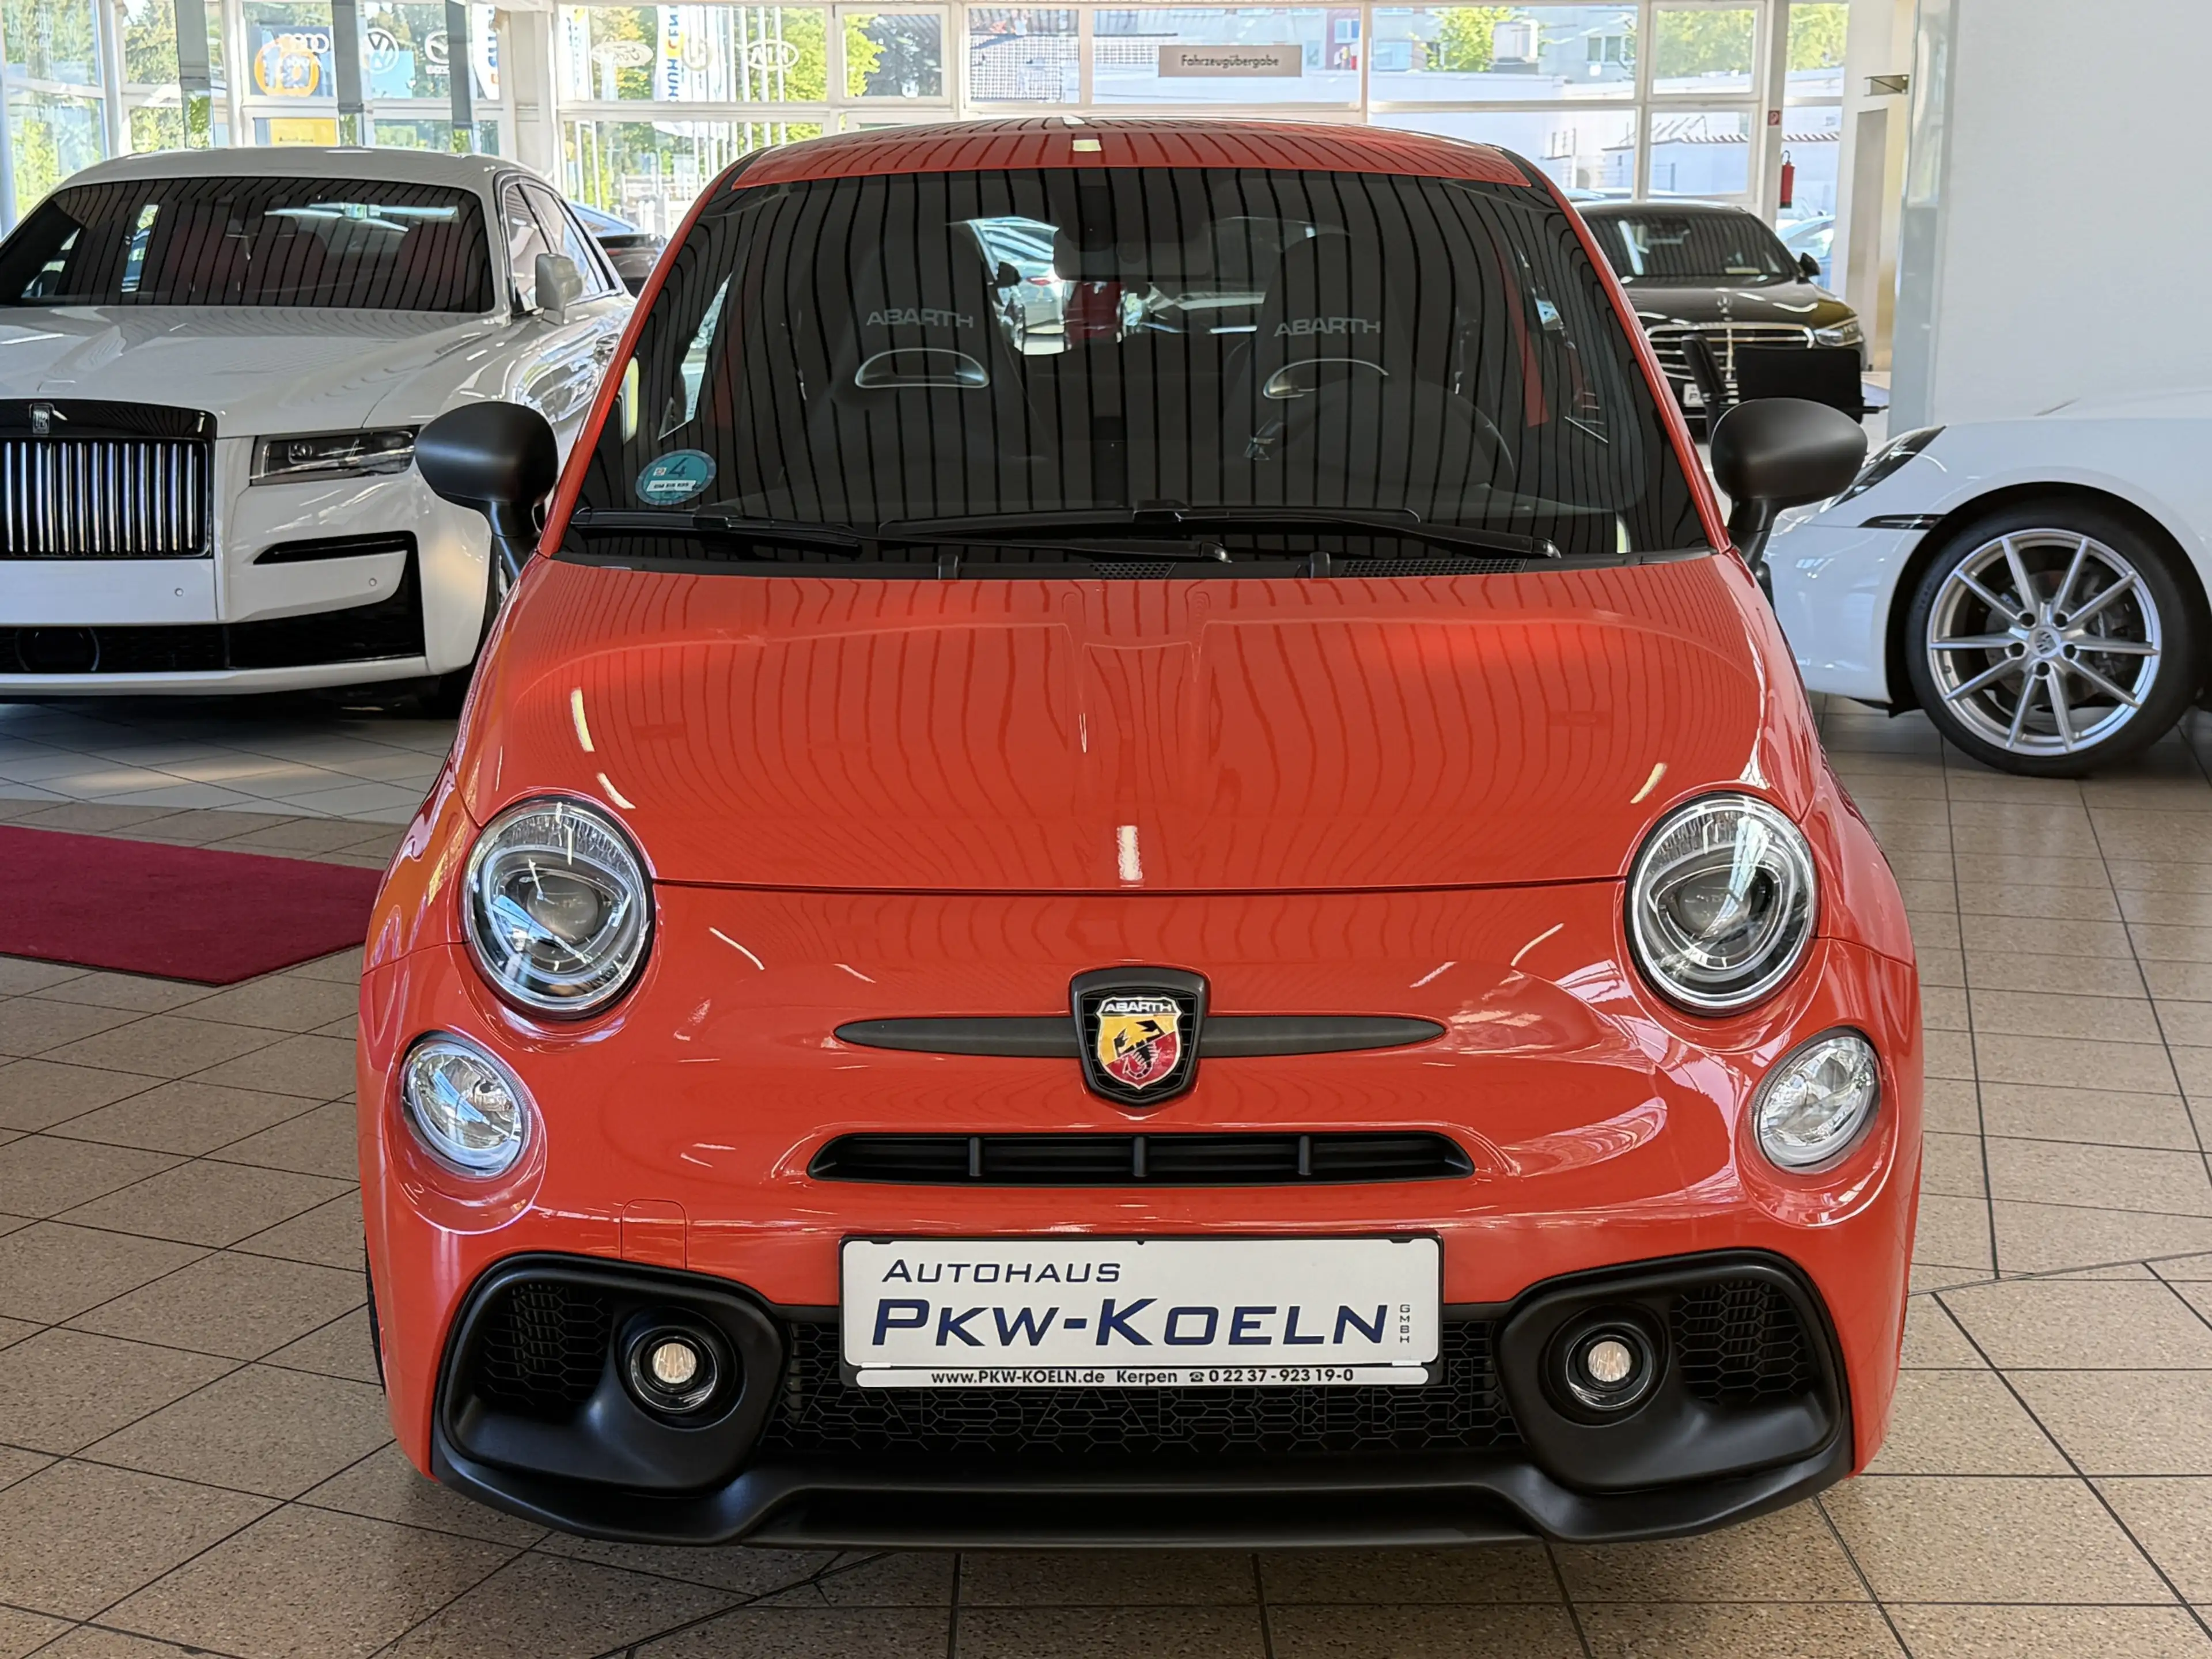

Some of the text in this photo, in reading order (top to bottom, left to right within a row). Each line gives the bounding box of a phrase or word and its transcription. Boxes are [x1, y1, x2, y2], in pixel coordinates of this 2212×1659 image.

[1181, 54, 1279, 69] Fahrzeugübergabe
[866, 308, 974, 328] ABARTH
[1274, 317, 1381, 337] ABARTH
[668, 457, 689, 478] 4
[1105, 1002, 1172, 1012] ABARTH
[882, 1259, 1120, 1283] AUTOHAUS
[872, 1298, 1388, 1347] PKW-KOELN
[931, 1370, 1105, 1383] www.PKW-KOELN.de
[1117, 1370, 1177, 1385] Kerpen
